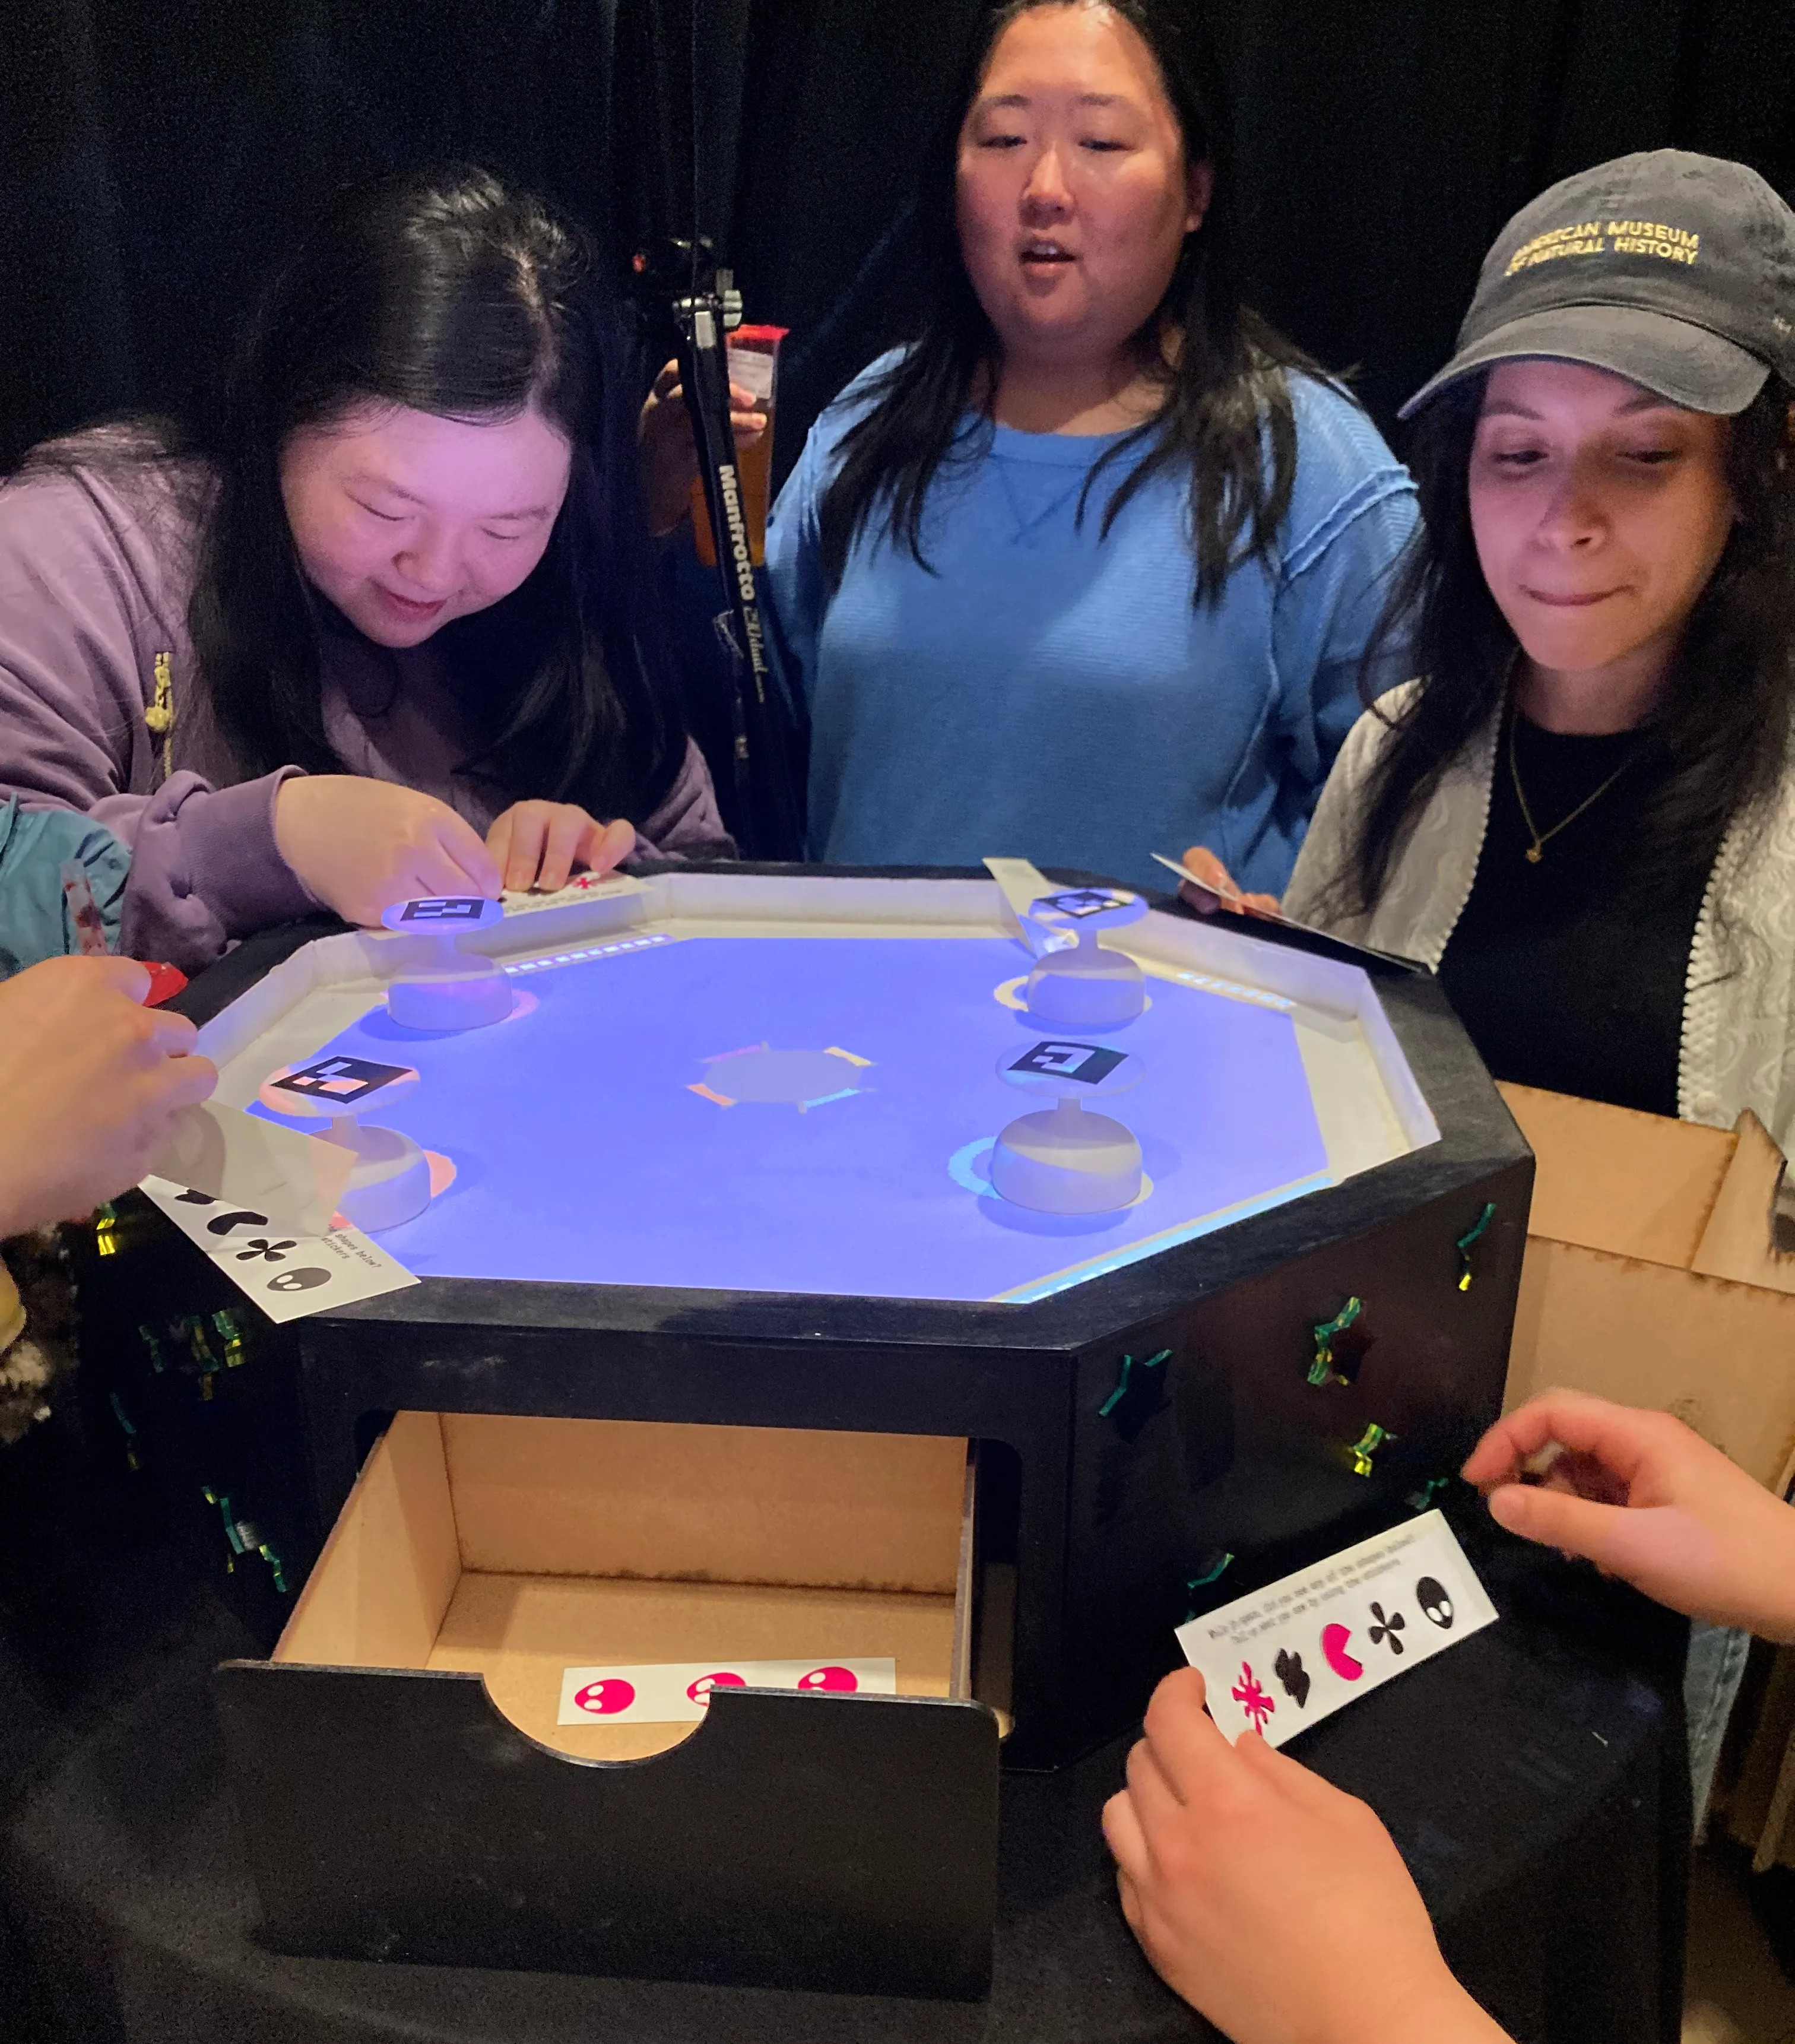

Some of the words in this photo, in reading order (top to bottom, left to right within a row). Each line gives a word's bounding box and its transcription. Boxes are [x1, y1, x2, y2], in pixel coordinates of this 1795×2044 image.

[1607, 220, 1699, 249] MUSEUM
[1614, 236, 1699, 265] HISTORY
[719, 465, 756, 601] Manfrotto
[321, 1237, 350, 1259] stickers
[335, 1234, 358, 1250] shapes
[356, 1250, 382, 1268] below?
